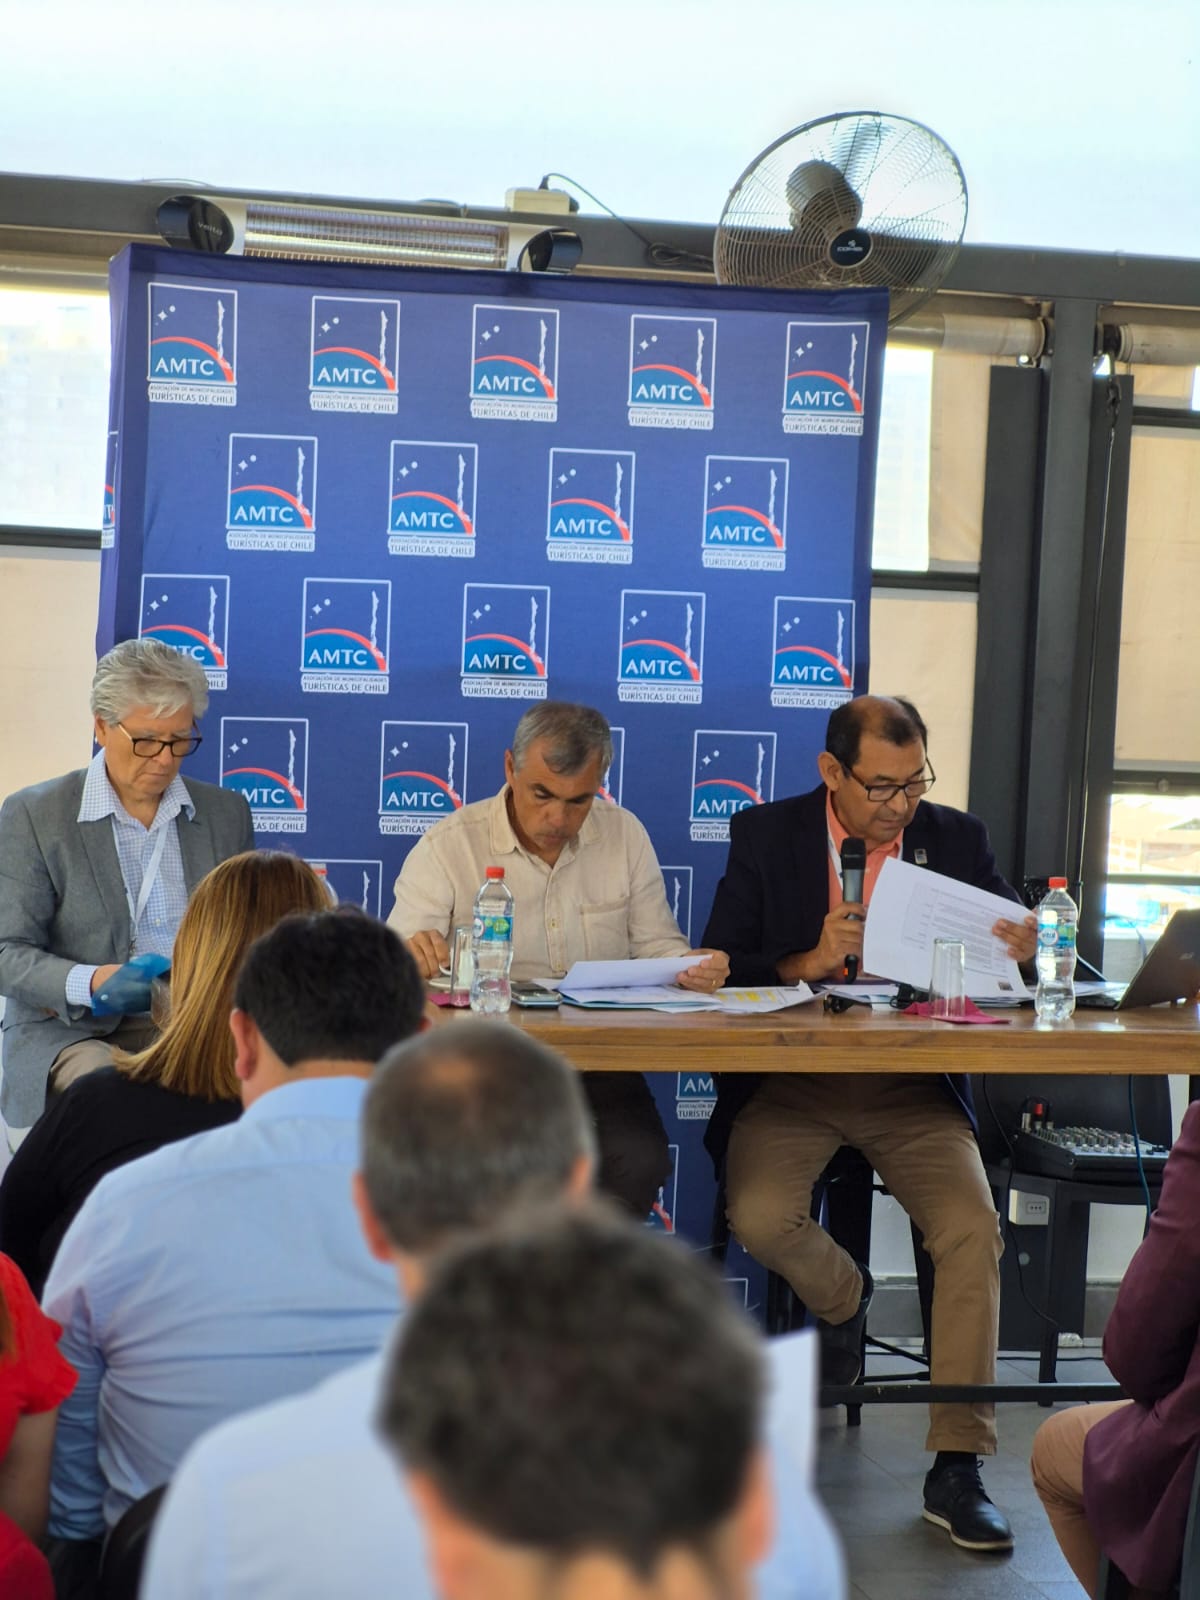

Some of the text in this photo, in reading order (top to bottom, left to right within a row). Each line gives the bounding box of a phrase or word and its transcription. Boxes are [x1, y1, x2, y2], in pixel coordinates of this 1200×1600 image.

[155, 356, 214, 376] AMTC
[317, 366, 376, 384] AMTC
[478, 374, 536, 392] AMTC
[151, 391, 196, 402] TURÍSTICAS
[212, 396, 234, 404] CHILE
[636, 383, 692, 401] AMTC
[790, 390, 845, 406] AMTC
[313, 400, 357, 410] TURÍSTICAS
[473, 408, 517, 417] TURÍSTICAS
[631, 416, 674, 425] TURÍSTICAS
[234, 505, 293, 522] AMTC
[396, 511, 454, 528] AMTC
[554, 518, 611, 535] AMTC
[710, 525, 765, 542] AMTC
[229, 539, 274, 548] TURÍSTICAS
[391, 545, 435, 553] TURÍSTICAS
[550, 551, 593, 560] TURÍSTICAS
[705, 558, 747, 567] TURÍSTICAS
[309, 648, 367, 665] AMTC
[469, 653, 526, 670] AMTC
[626, 659, 682, 675] AMTC
[779, 664, 833, 681] AMTC
[304, 682, 348, 690] TURÍSTICAS
[464, 687, 508, 695] TURÍSTICAS
[620, 692, 663, 700] TURÍSTICAS
[774, 697, 816, 706] TURÍSTICAS
[232, 788, 285, 804] MTC
[387, 791, 444, 807] AMTC
[692, 832, 730, 840] TURÍSTICA
[684, 1078, 713, 1092] AM
